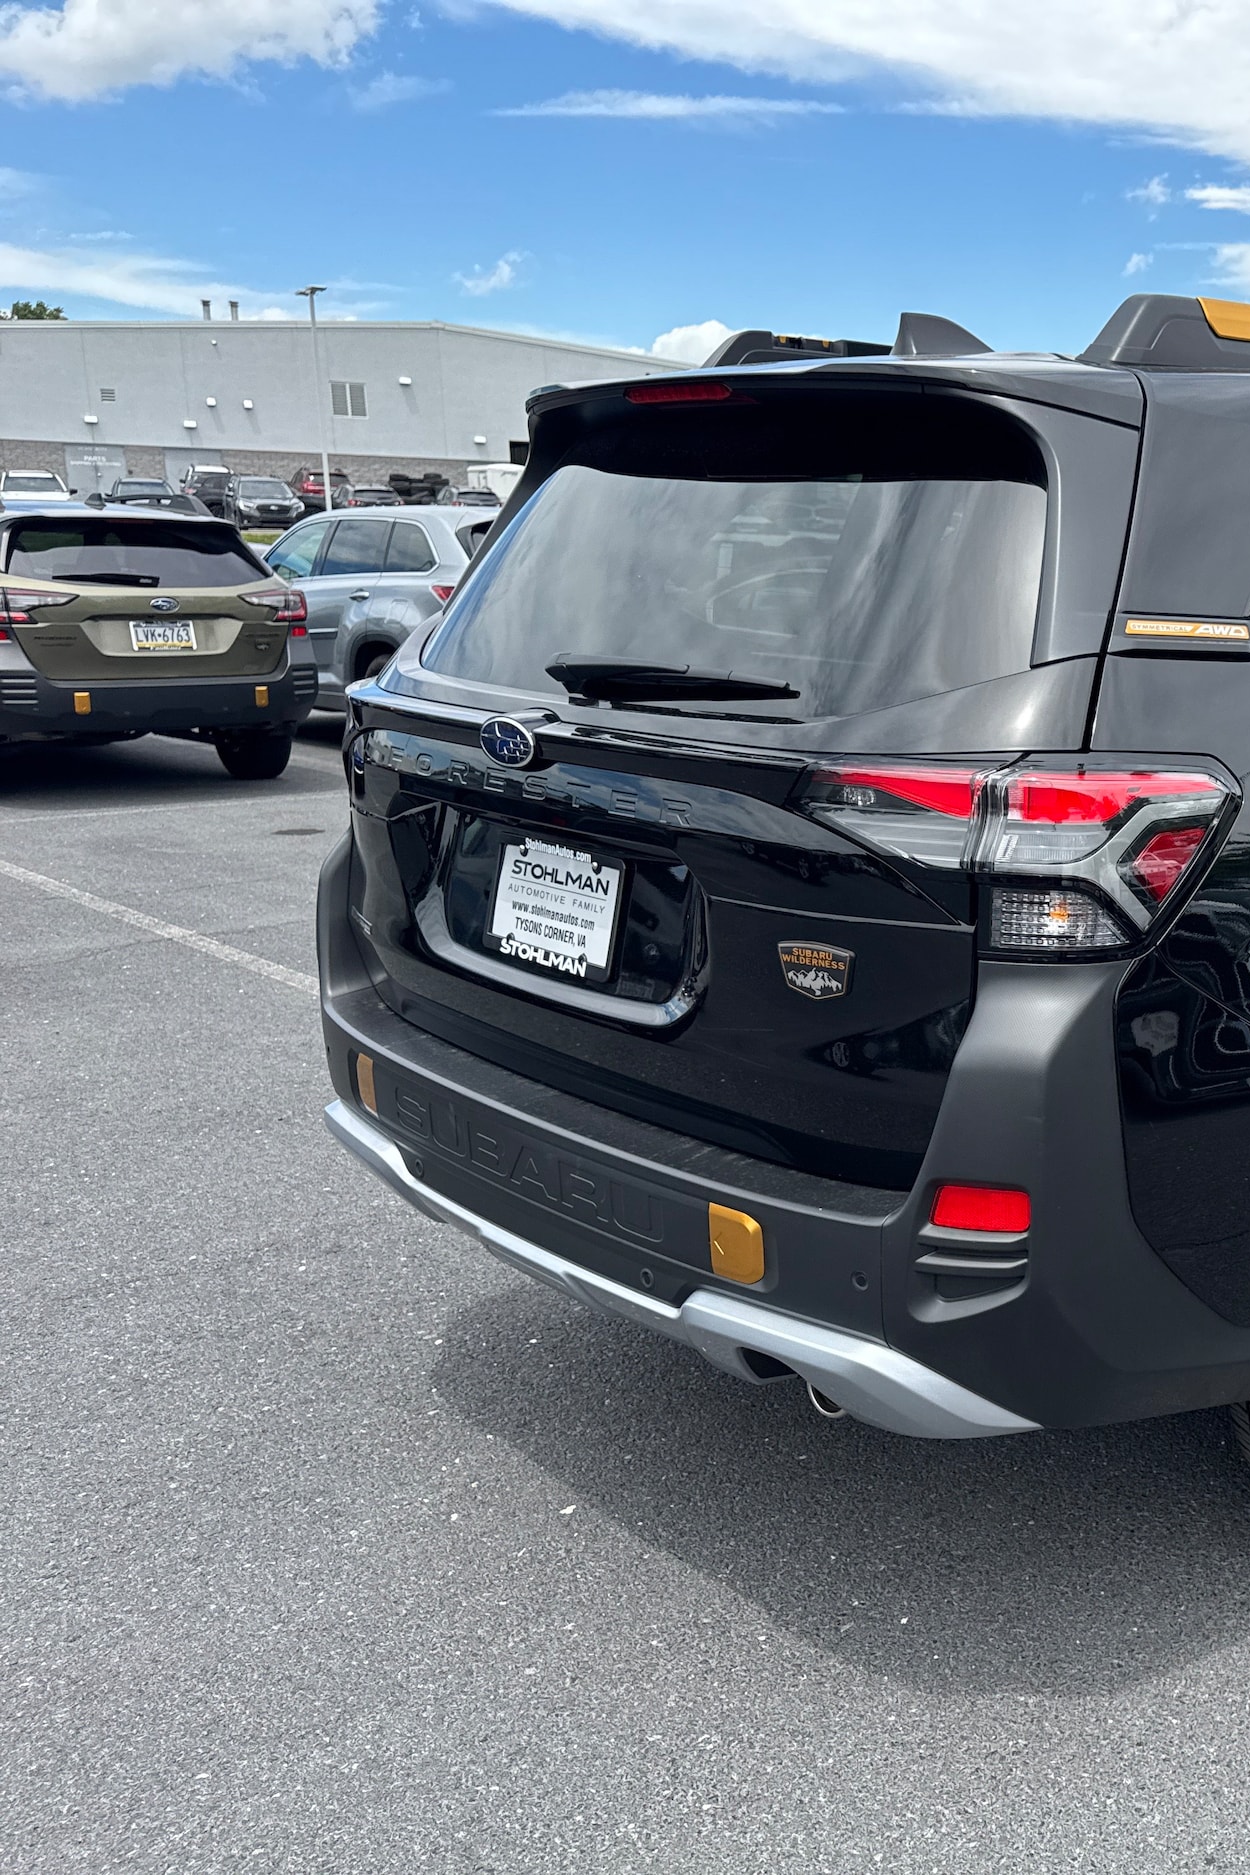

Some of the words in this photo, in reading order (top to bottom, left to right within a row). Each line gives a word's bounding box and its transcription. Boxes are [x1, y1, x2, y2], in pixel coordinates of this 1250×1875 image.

[1131, 624, 1189, 632] SYMMETRICAL
[1195, 624, 1246, 637] AWD
[387, 746, 696, 826] FORESTER
[525, 837, 592, 864] StohlmanAutos.com
[511, 859, 610, 896] STOHLMAN
[508, 883, 567, 905] AUTOMOTIVE
[572, 898, 606, 914] FAMILY
[512, 900, 595, 931] www.stohlmanautos.com
[515, 916, 543, 936] TYSONS
[543, 926, 576, 948] CORNER,
[577, 933, 586, 948] VA
[500, 937, 587, 977] STOHLMAN
[782, 953, 846, 970] WILDERNESS
[792, 947, 833, 961] SUBARU
[395, 1086, 664, 1243] SUBARU
